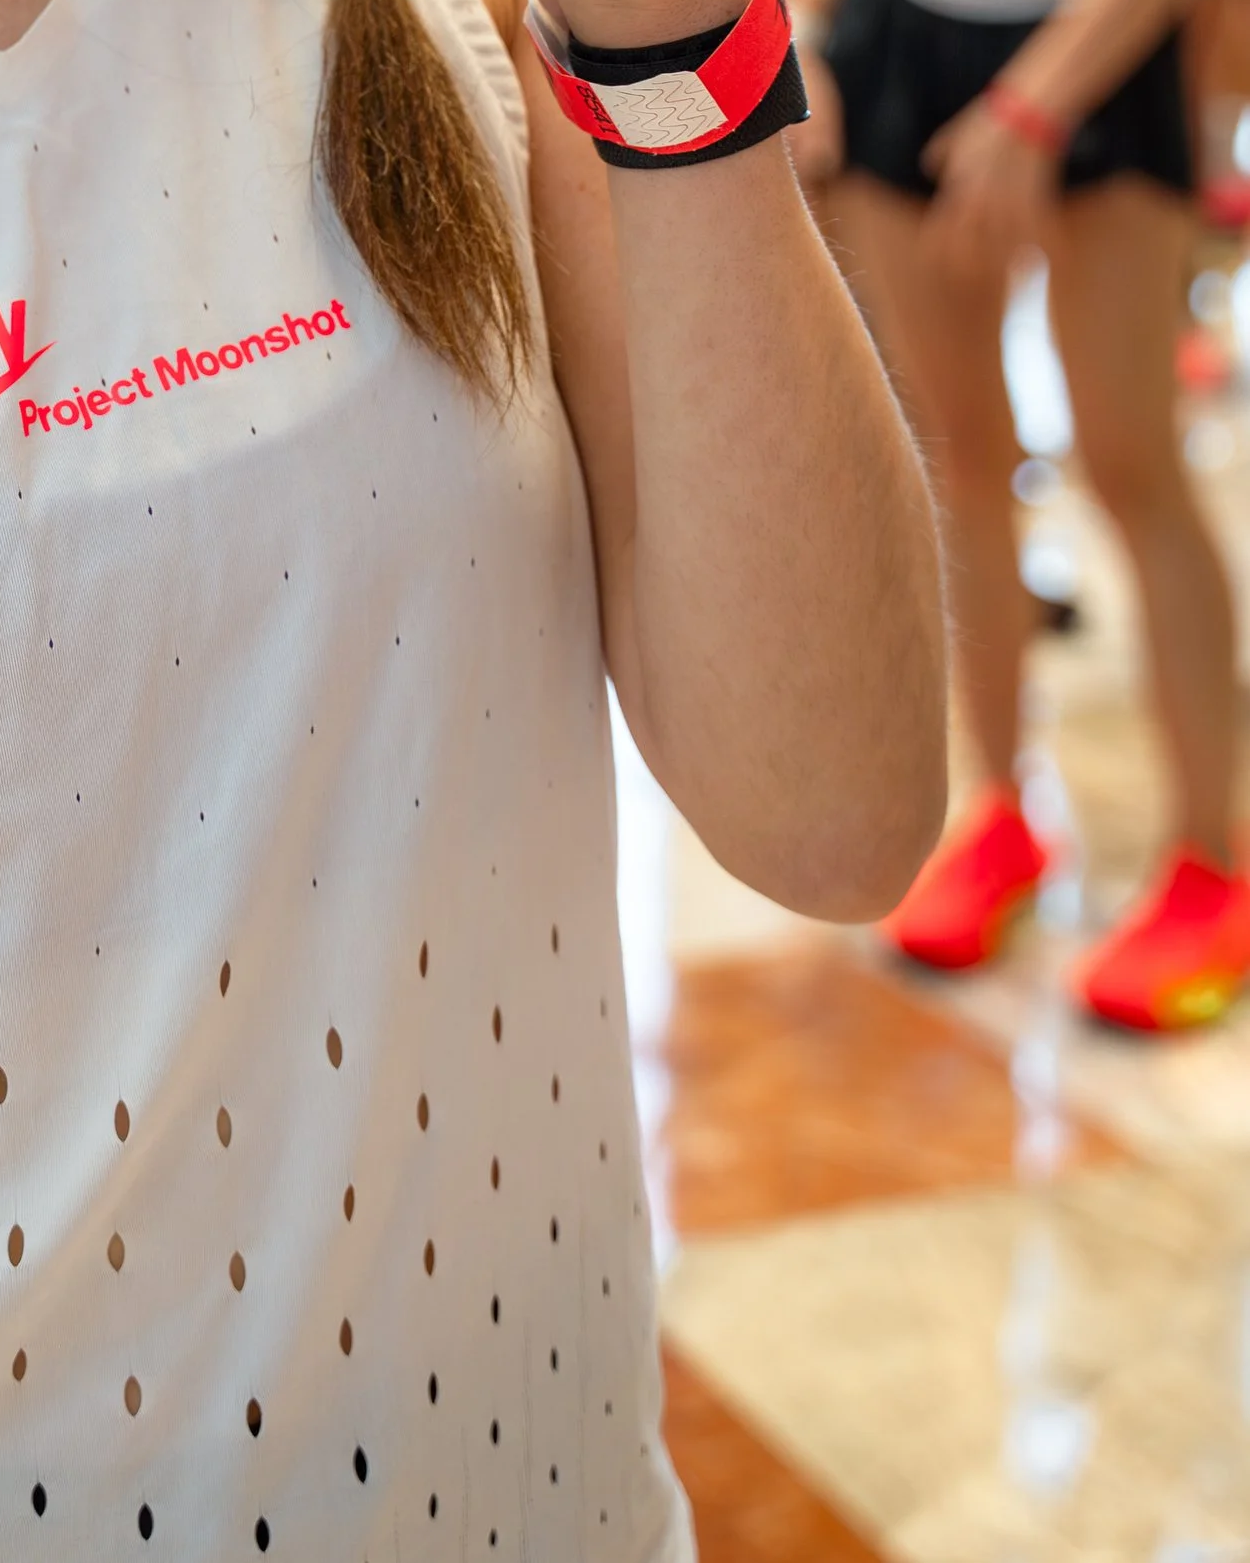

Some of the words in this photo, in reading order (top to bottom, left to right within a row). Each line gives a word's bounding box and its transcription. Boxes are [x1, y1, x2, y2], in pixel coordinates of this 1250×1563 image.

[575, 85, 620, 135] 8541
[18, 367, 153, 438] Project
[153, 298, 352, 392] Moonshot
